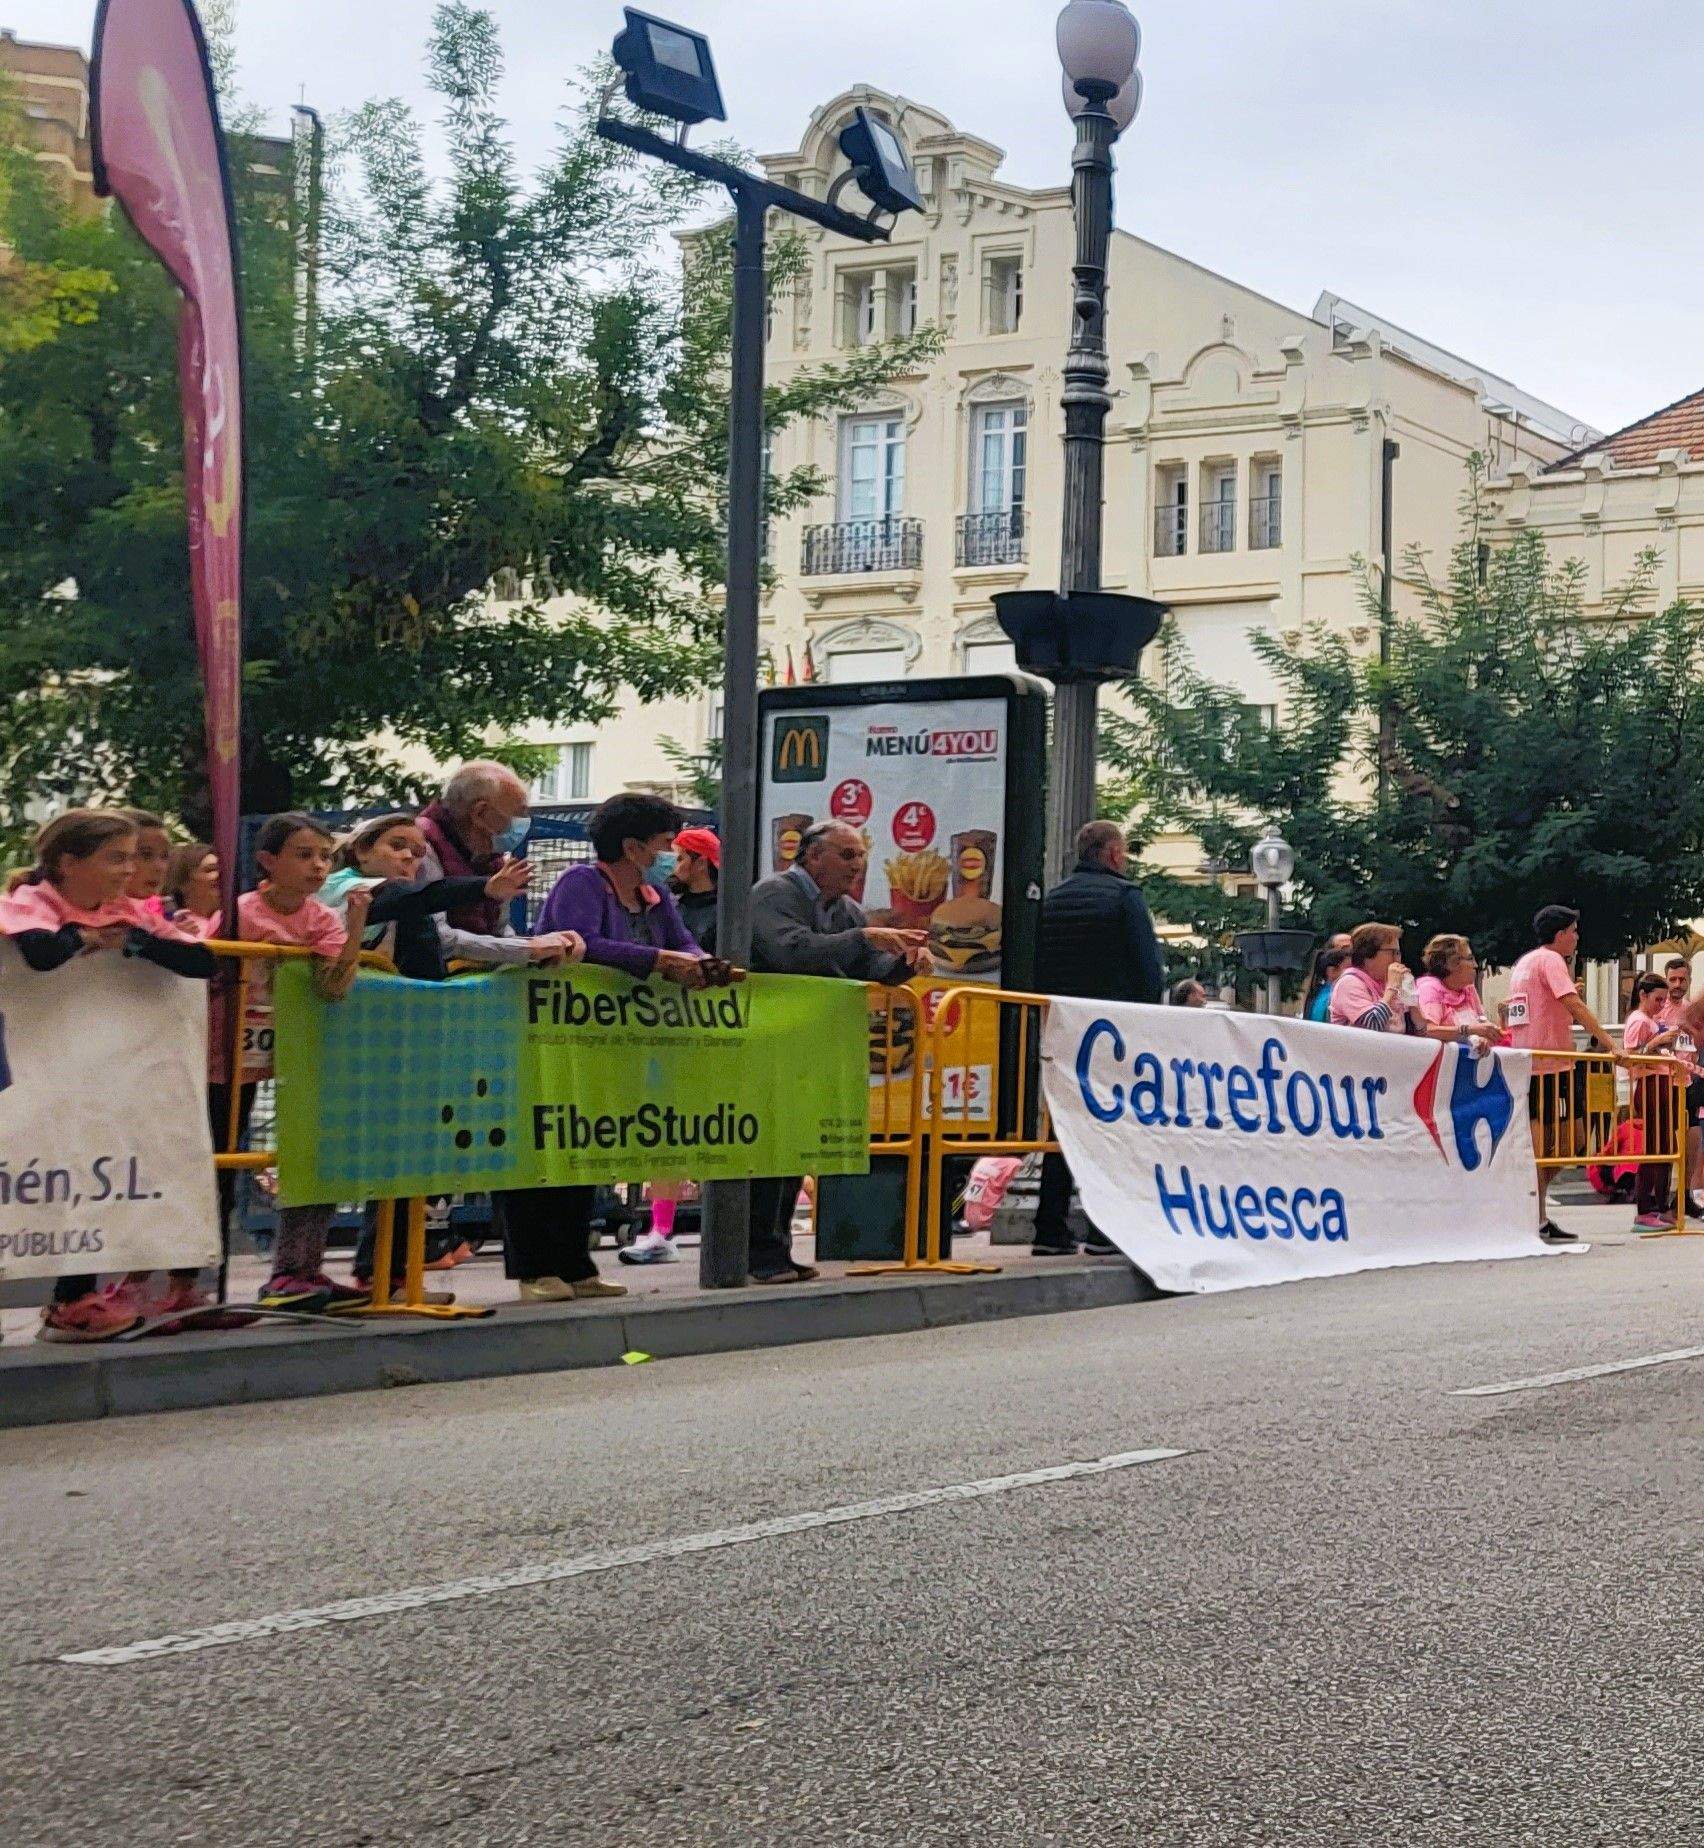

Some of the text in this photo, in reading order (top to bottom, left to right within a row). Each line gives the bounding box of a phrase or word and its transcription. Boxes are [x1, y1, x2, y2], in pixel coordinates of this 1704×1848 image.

[527, 978, 745, 1029] FiberSalud
[1075, 1018, 1388, 1140] Carrefour
[532, 1103, 759, 1151] FiberStudio
[89, 1156, 163, 1202] S.L.
[1155, 1163, 1349, 1242] Huesca
